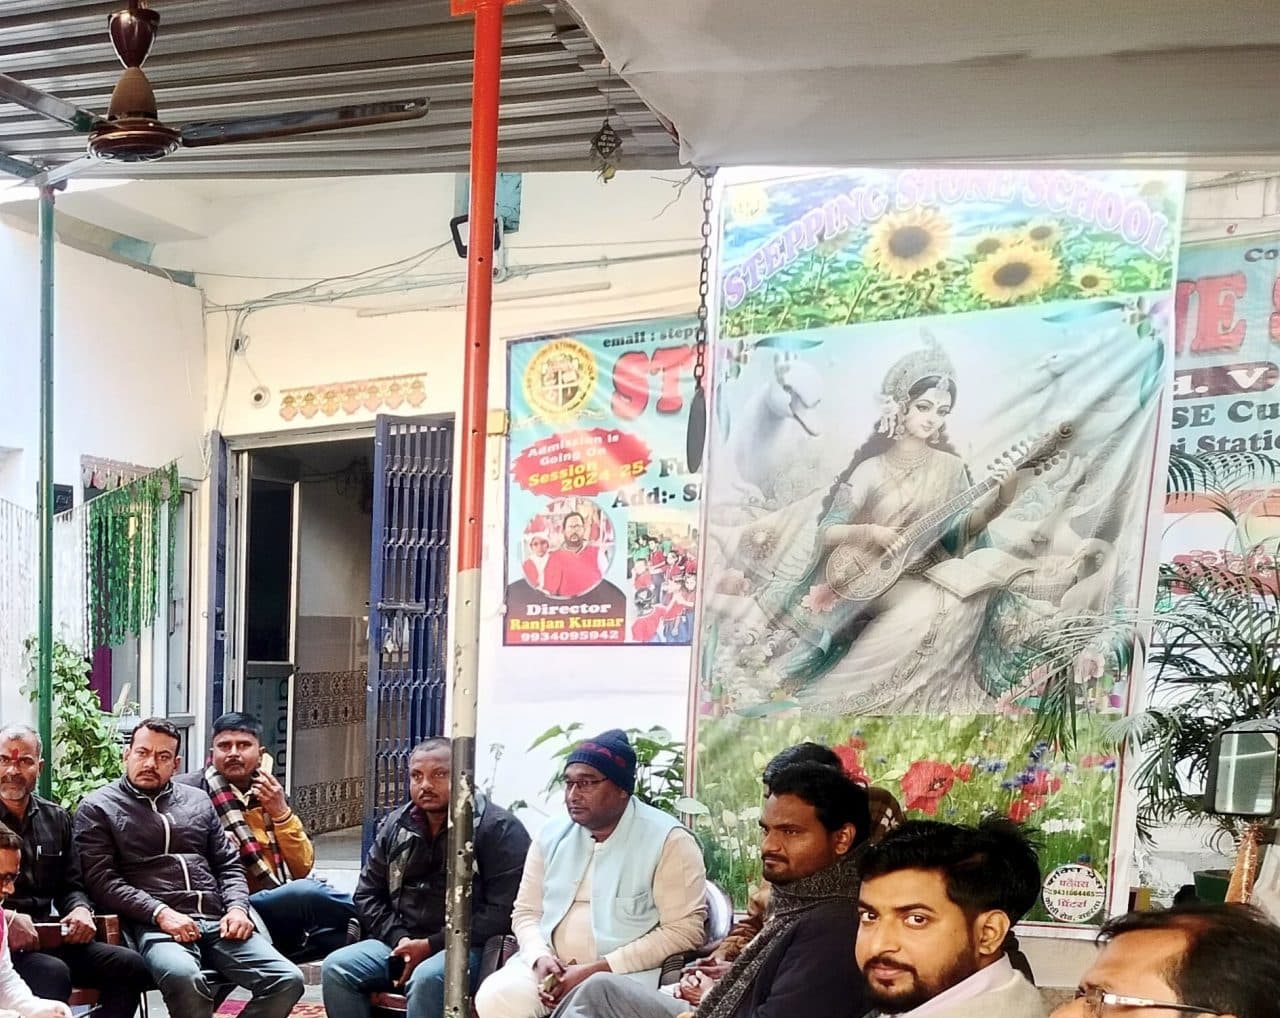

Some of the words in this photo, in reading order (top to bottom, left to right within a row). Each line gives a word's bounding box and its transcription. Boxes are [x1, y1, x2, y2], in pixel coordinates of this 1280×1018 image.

[723, 186, 889, 310] STEPPING
[1021, 168, 1169, 261] SCHOOL
[603, 331, 645, 348] email
[1227, 367, 1270, 389] V
[540, 451, 581, 466] Going
[528, 461, 598, 488] Session
[526, 603, 611, 616] Director
[510, 618, 565, 632] Ranjan
[569, 617, 624, 629] Kumar
